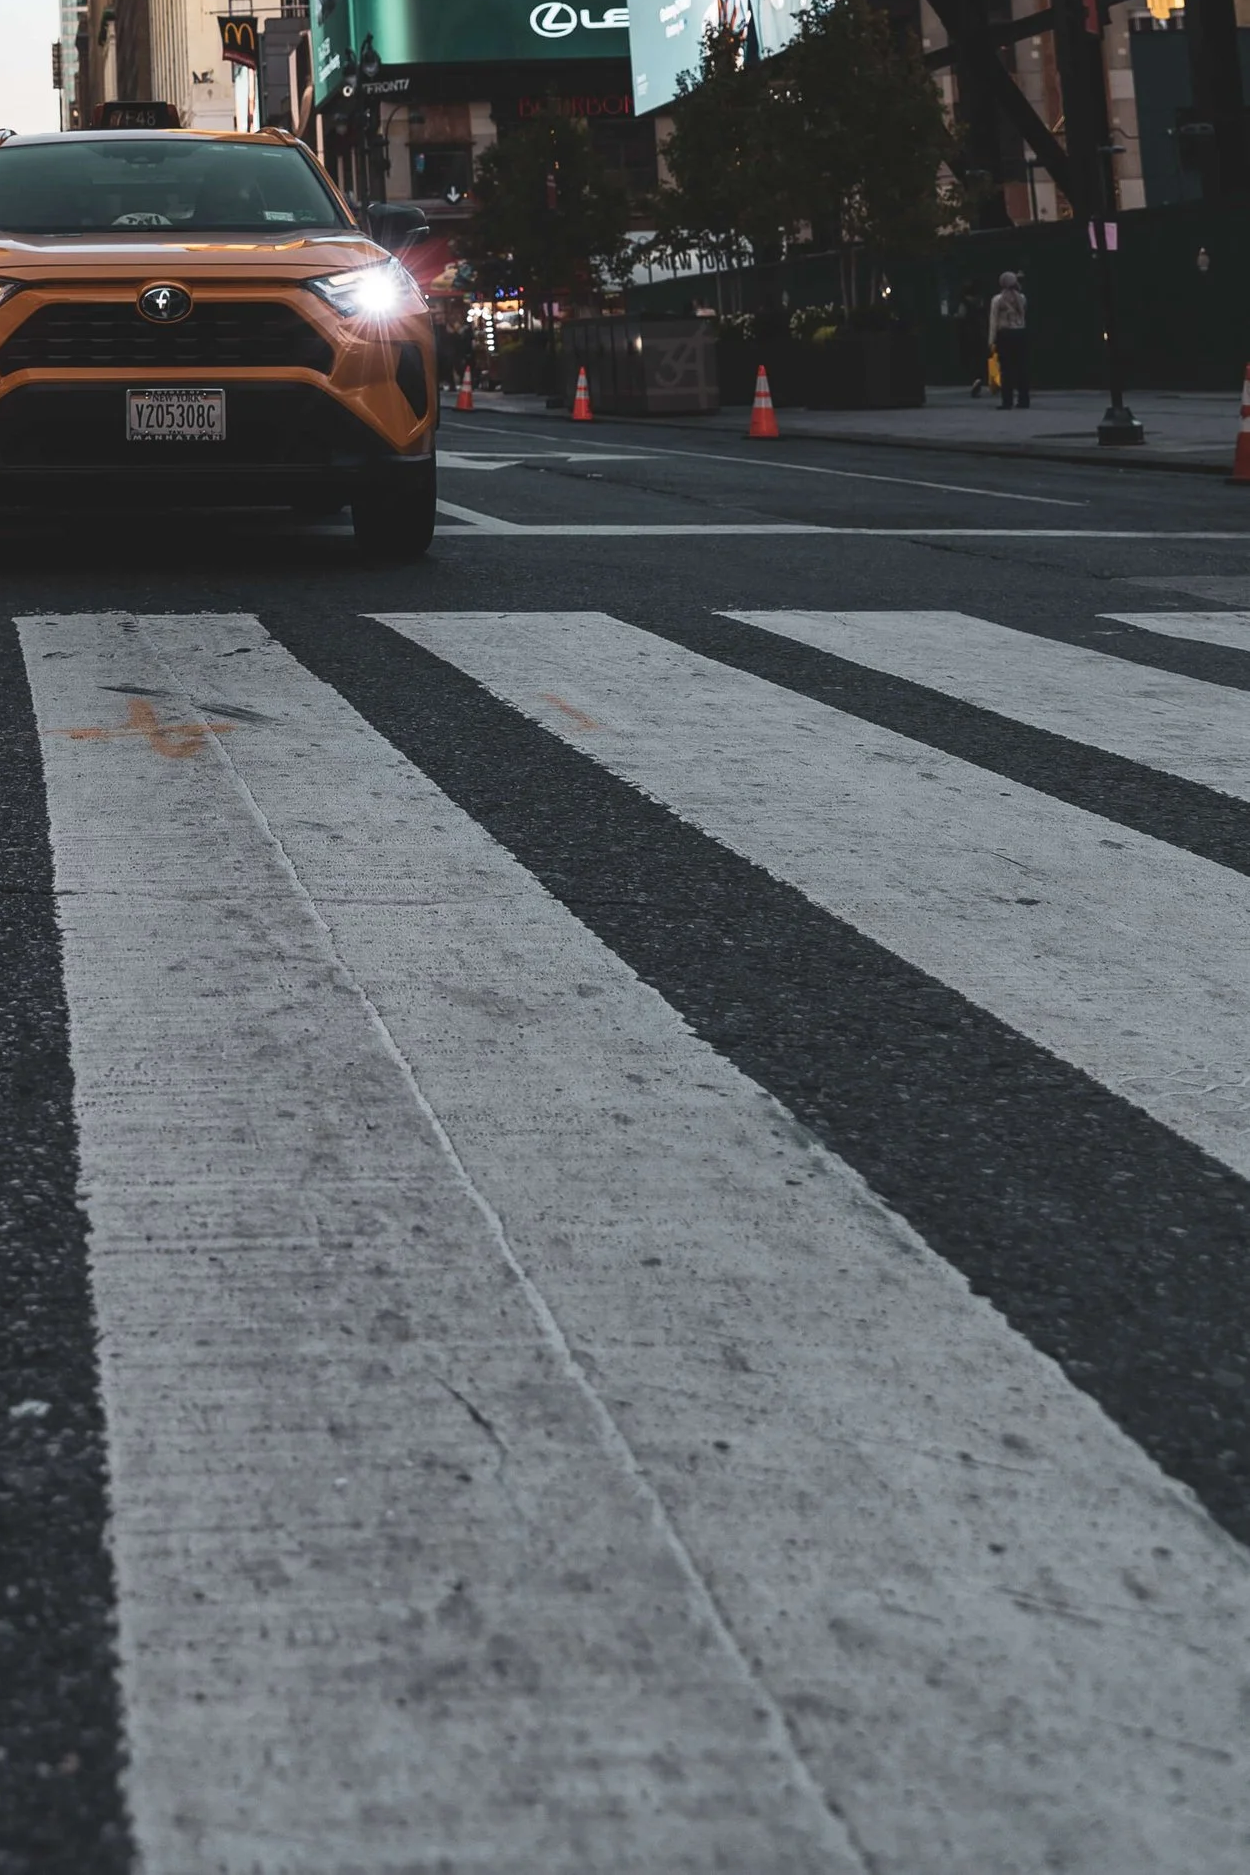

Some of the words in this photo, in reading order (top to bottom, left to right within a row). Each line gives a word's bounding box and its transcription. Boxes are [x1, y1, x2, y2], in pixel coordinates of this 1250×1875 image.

[152, 395, 172, 403] NEW
[174, 395, 201, 403] YORK
[135, 404, 216, 428] Y205308C
